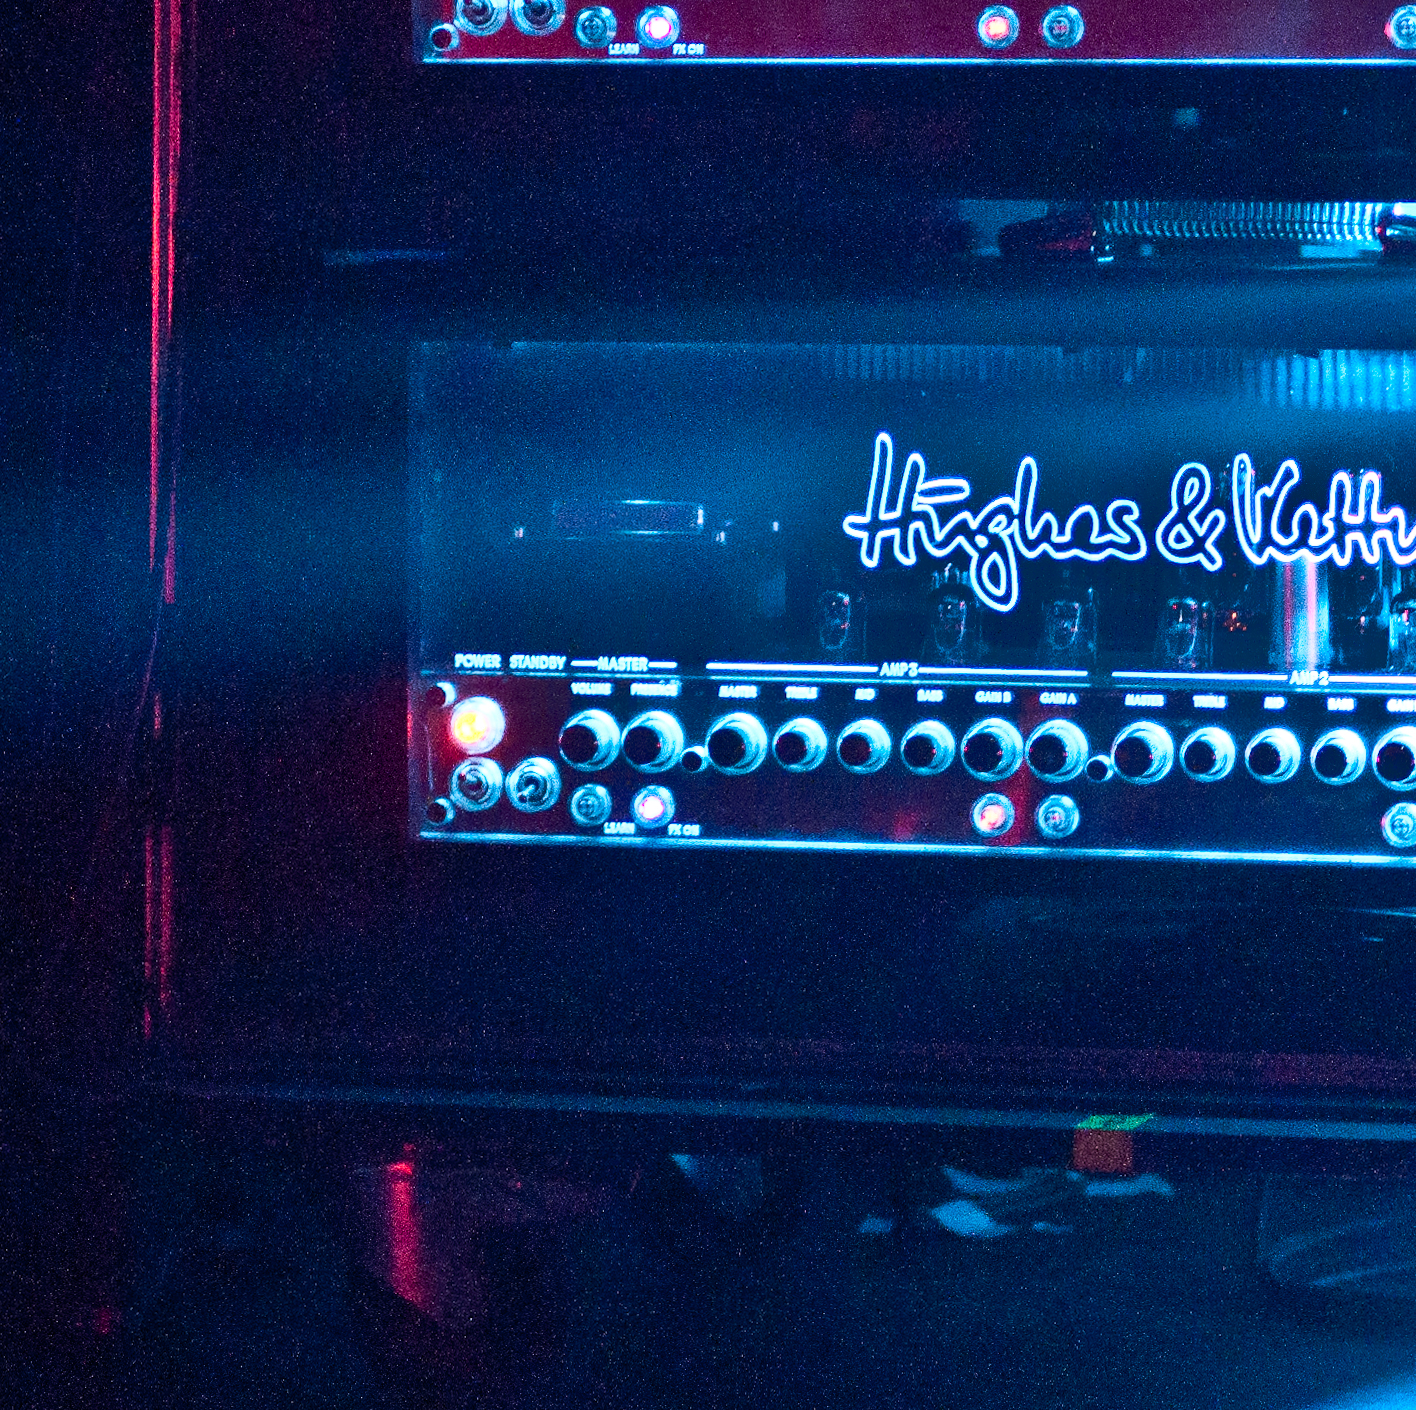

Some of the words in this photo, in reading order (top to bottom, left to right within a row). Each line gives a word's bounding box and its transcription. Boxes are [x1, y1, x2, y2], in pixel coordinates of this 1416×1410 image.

[843, 433, 1147, 611] Hughes
[1155, 463, 1223, 572] &
[454, 654, 501, 668] POWER
[510, 655, 565, 669] STANDBY
[598, 657, 648, 671] MASTER
[880, 663, 908, 677] AMP
[908, 663, 918, 677] 3
[1290, 671, 1318, 685] AMP
[1319, 671, 1329, 685] 2
